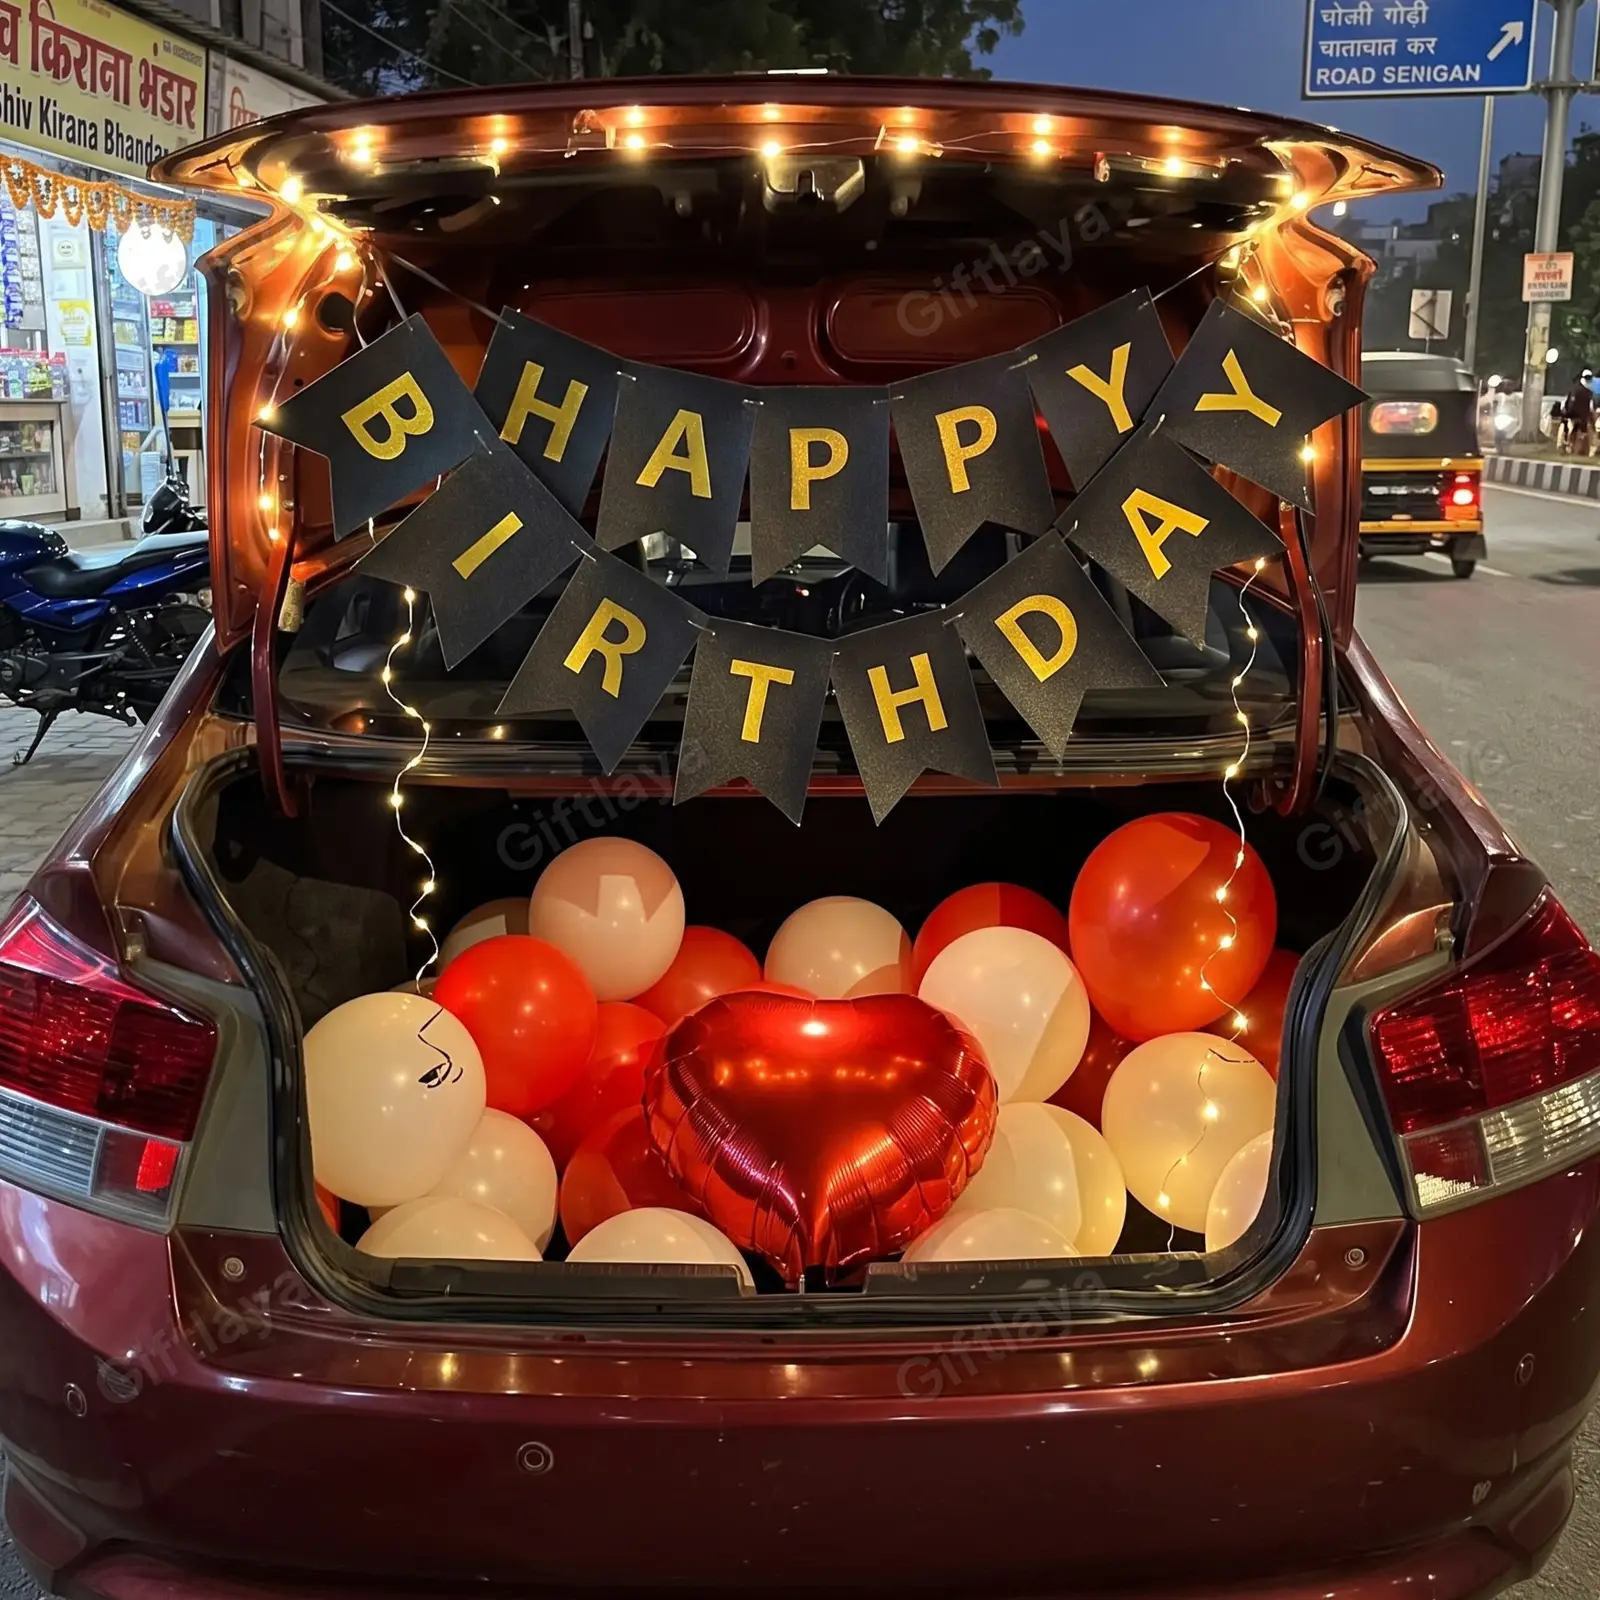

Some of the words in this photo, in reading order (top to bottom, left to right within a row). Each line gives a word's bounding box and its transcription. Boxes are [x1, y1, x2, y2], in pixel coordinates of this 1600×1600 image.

[29, 0, 133, 106] किराना
[138, 42, 198, 130] भंडार
[1316, 67, 1377, 85] ROAD
[1383, 64, 1481, 84] SENIGAN
[1406, 36, 1438, 56] कर
[0, 82, 32, 130] hiv
[39, 95, 98, 151] Kirana
[499, 342, 1132, 511] HAPPY
[340, 348, 1283, 744] BIRTHDAY
